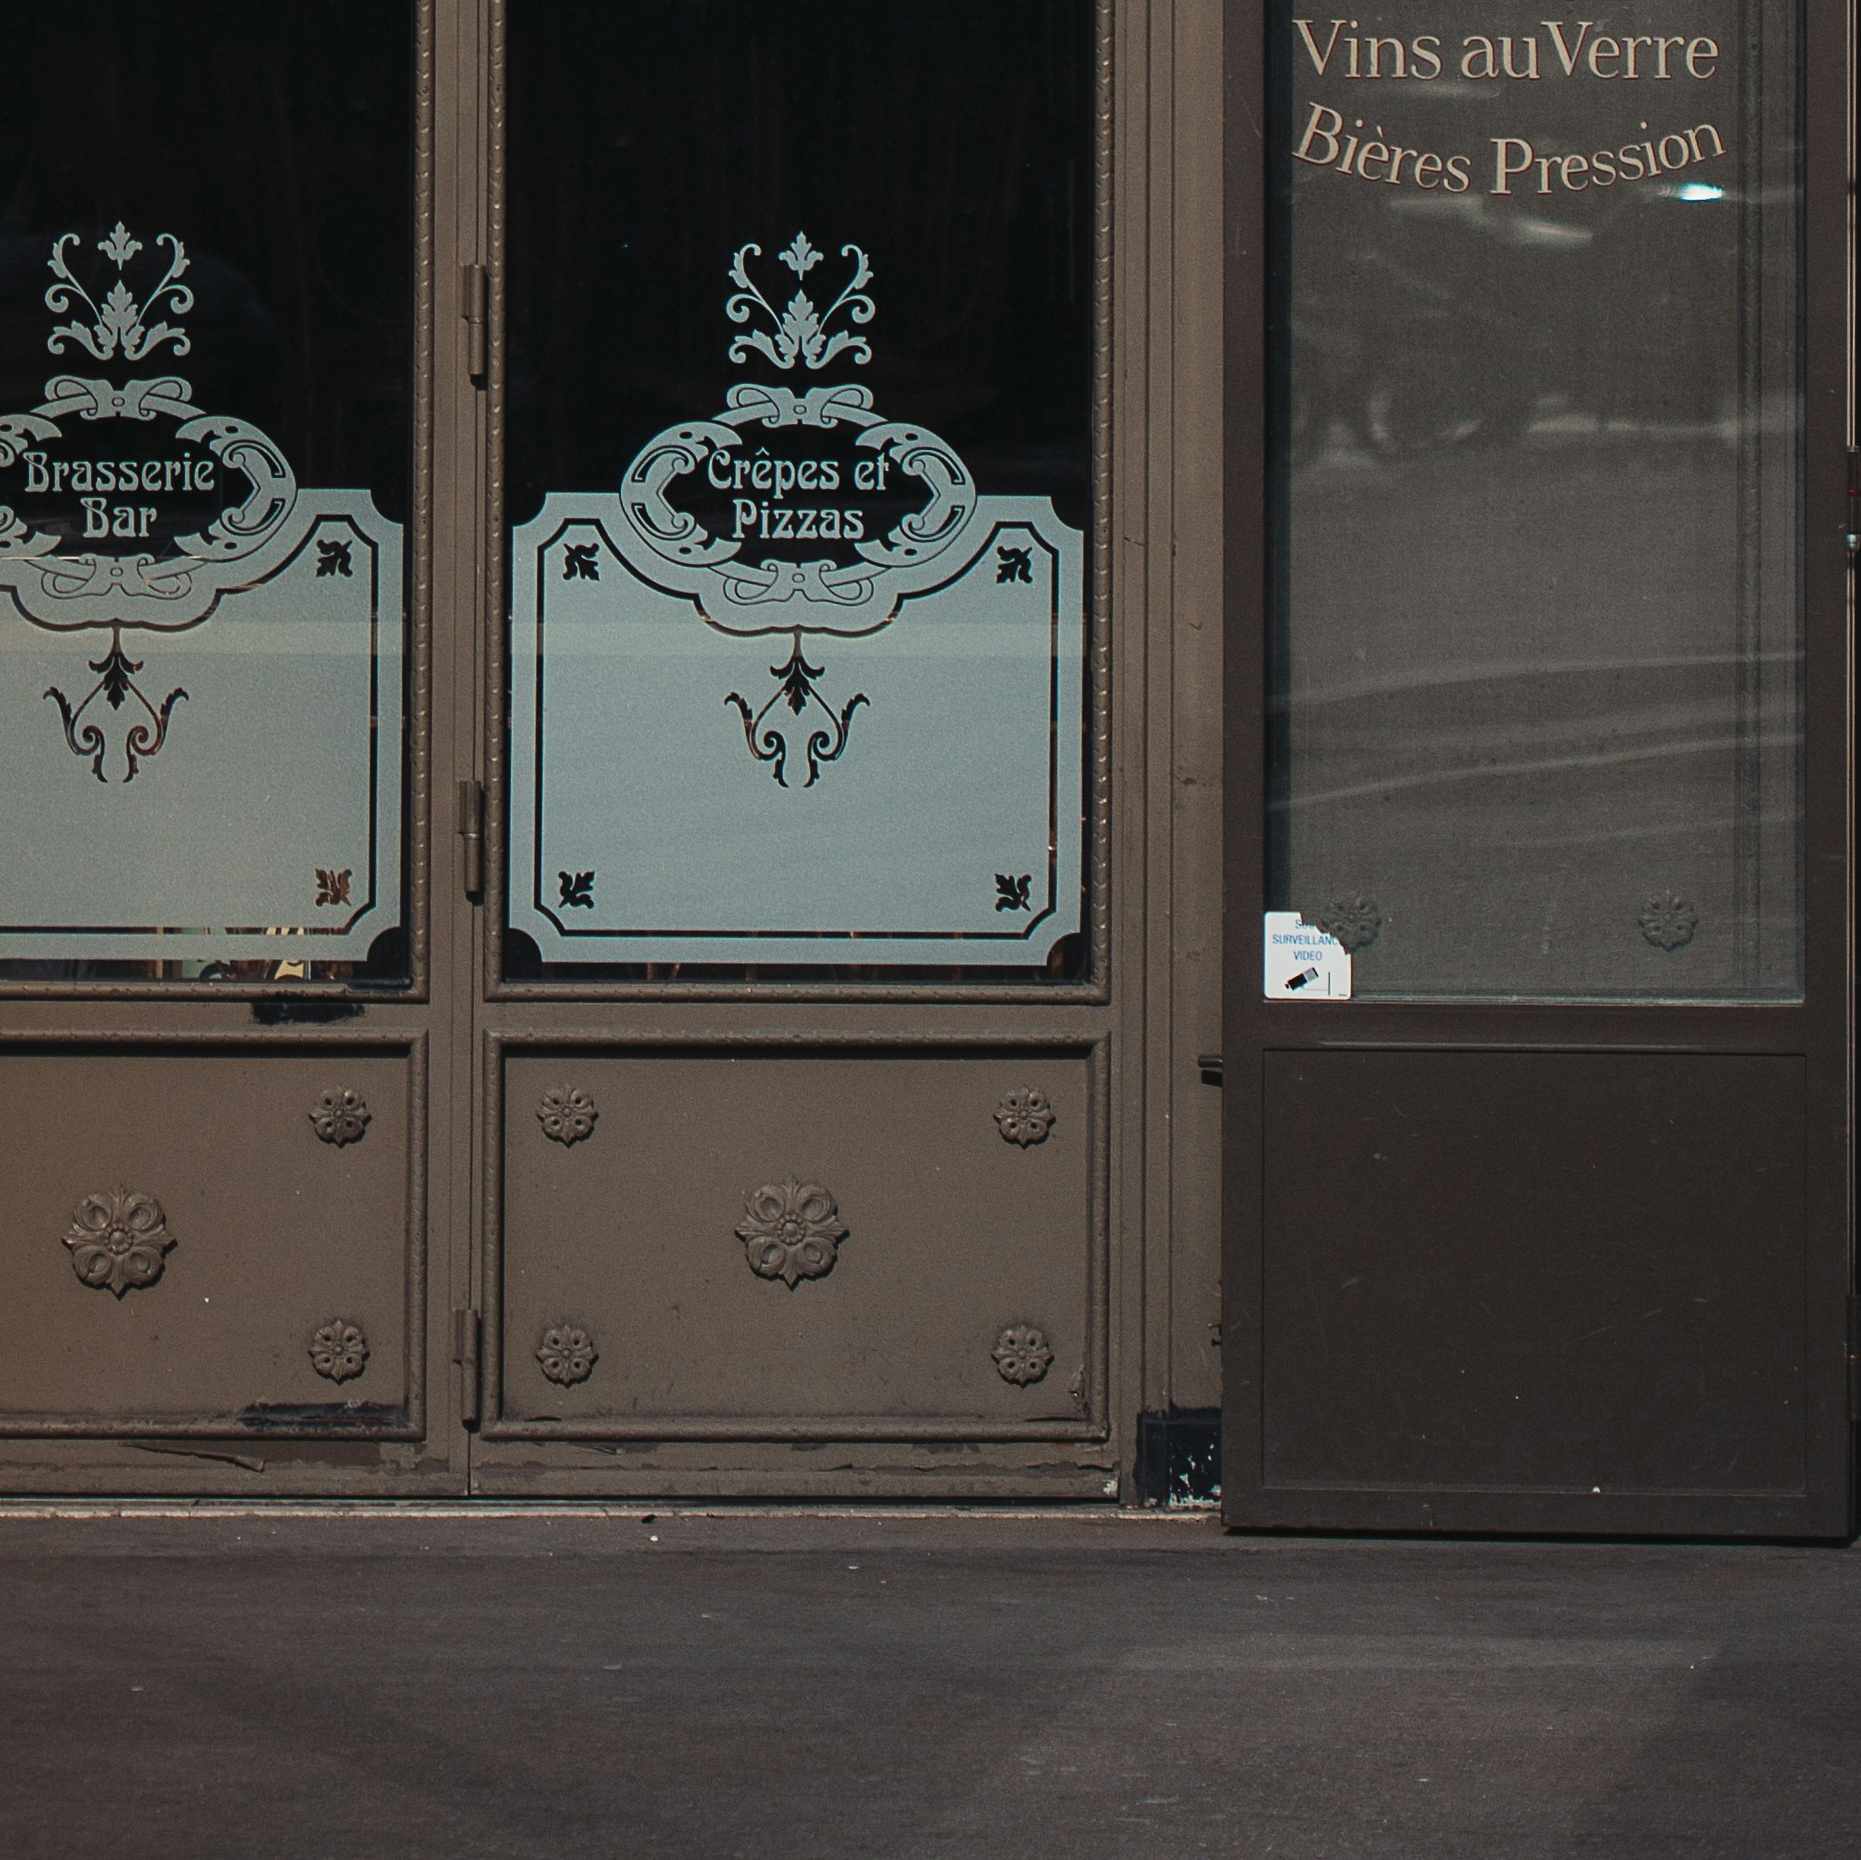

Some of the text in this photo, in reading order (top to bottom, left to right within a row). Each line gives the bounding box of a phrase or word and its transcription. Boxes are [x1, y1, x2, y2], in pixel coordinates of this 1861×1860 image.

[1292, 19, 1443, 80] Vins
[1292, 101, 1727, 196] Bières Pression
[22, 452, 215, 493] Brasserie
[708, 446, 890, 499] Crêpes et
[80, 497, 158, 539] Bar
[732, 498, 865, 540] Pizzas
[1272, 934, 1338, 946] SURVEILLANC
[1293, 950, 1323, 961] VIDEO
